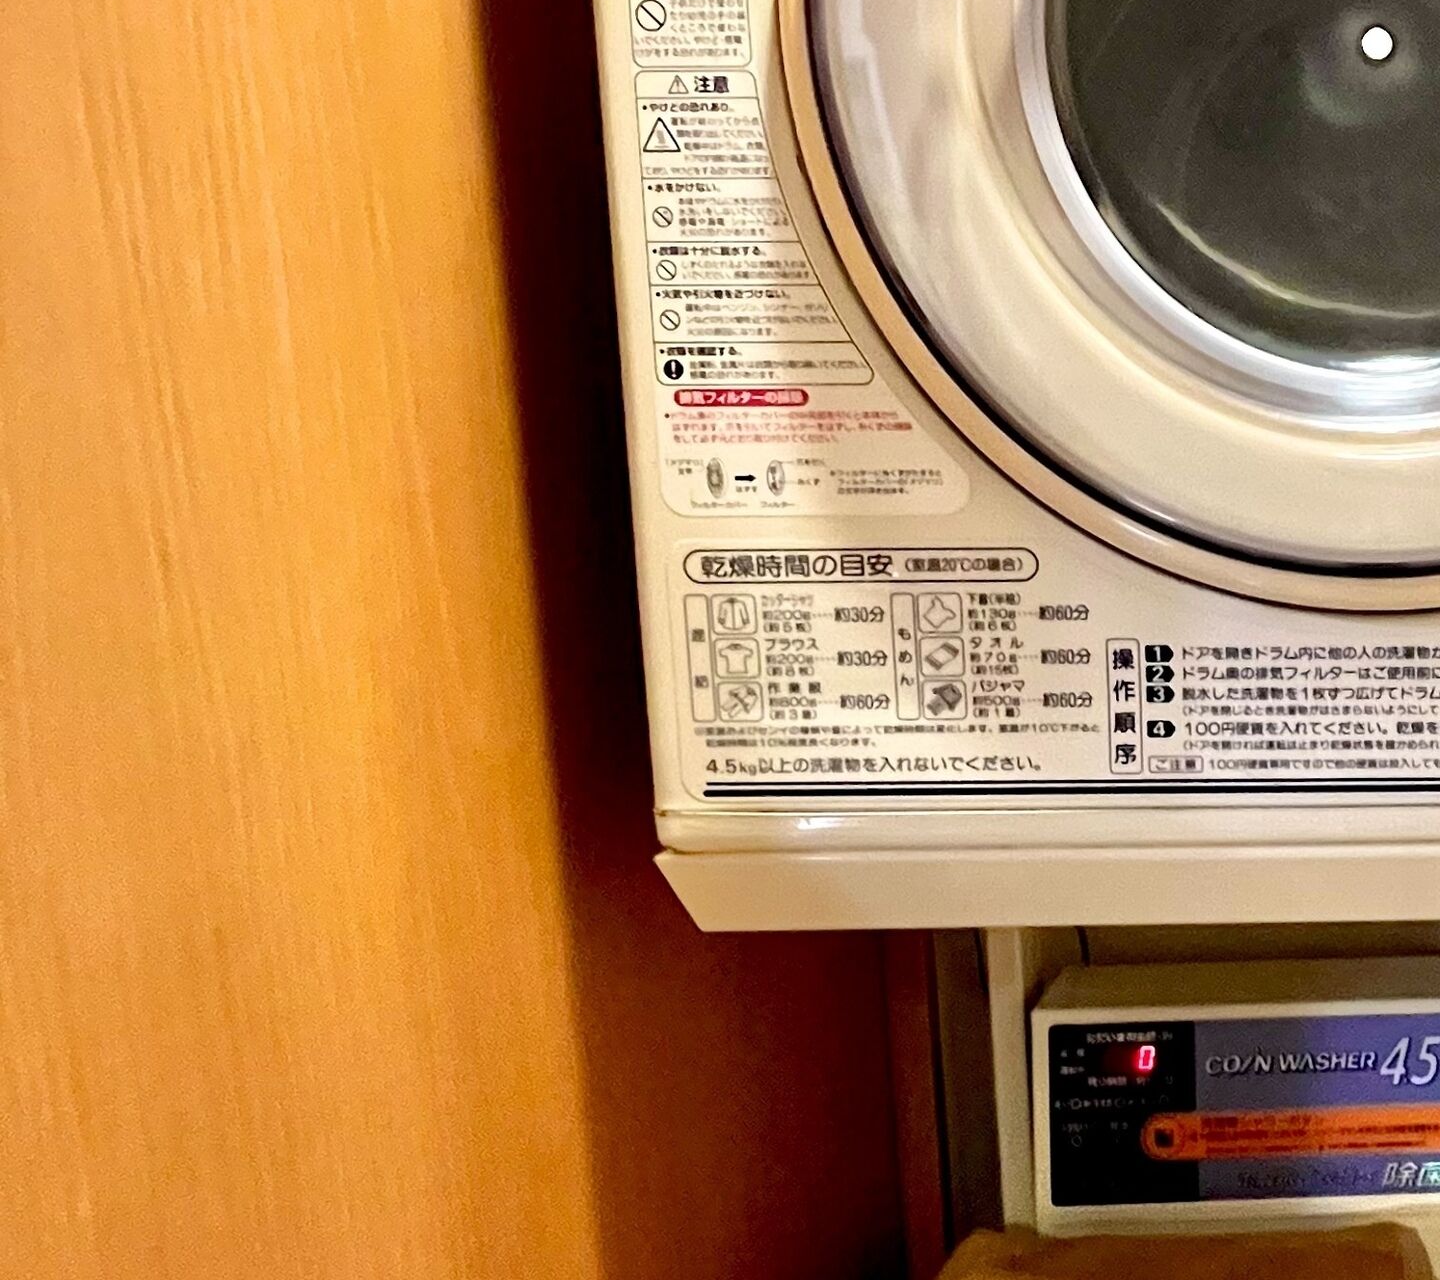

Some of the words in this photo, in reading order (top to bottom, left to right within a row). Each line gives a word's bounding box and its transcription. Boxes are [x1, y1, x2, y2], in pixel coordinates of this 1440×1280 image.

[701, 554, 893, 579] 乾燥時間の目安
[1152, 646, 1162, 662] 1
[1152, 666, 1165, 682] 2
[1153, 686, 1166, 703] 3
[1152, 721, 1166, 737] 4
[1138, 1045, 1156, 1071] 0
[1279, 1051, 1376, 1071] WASHER
